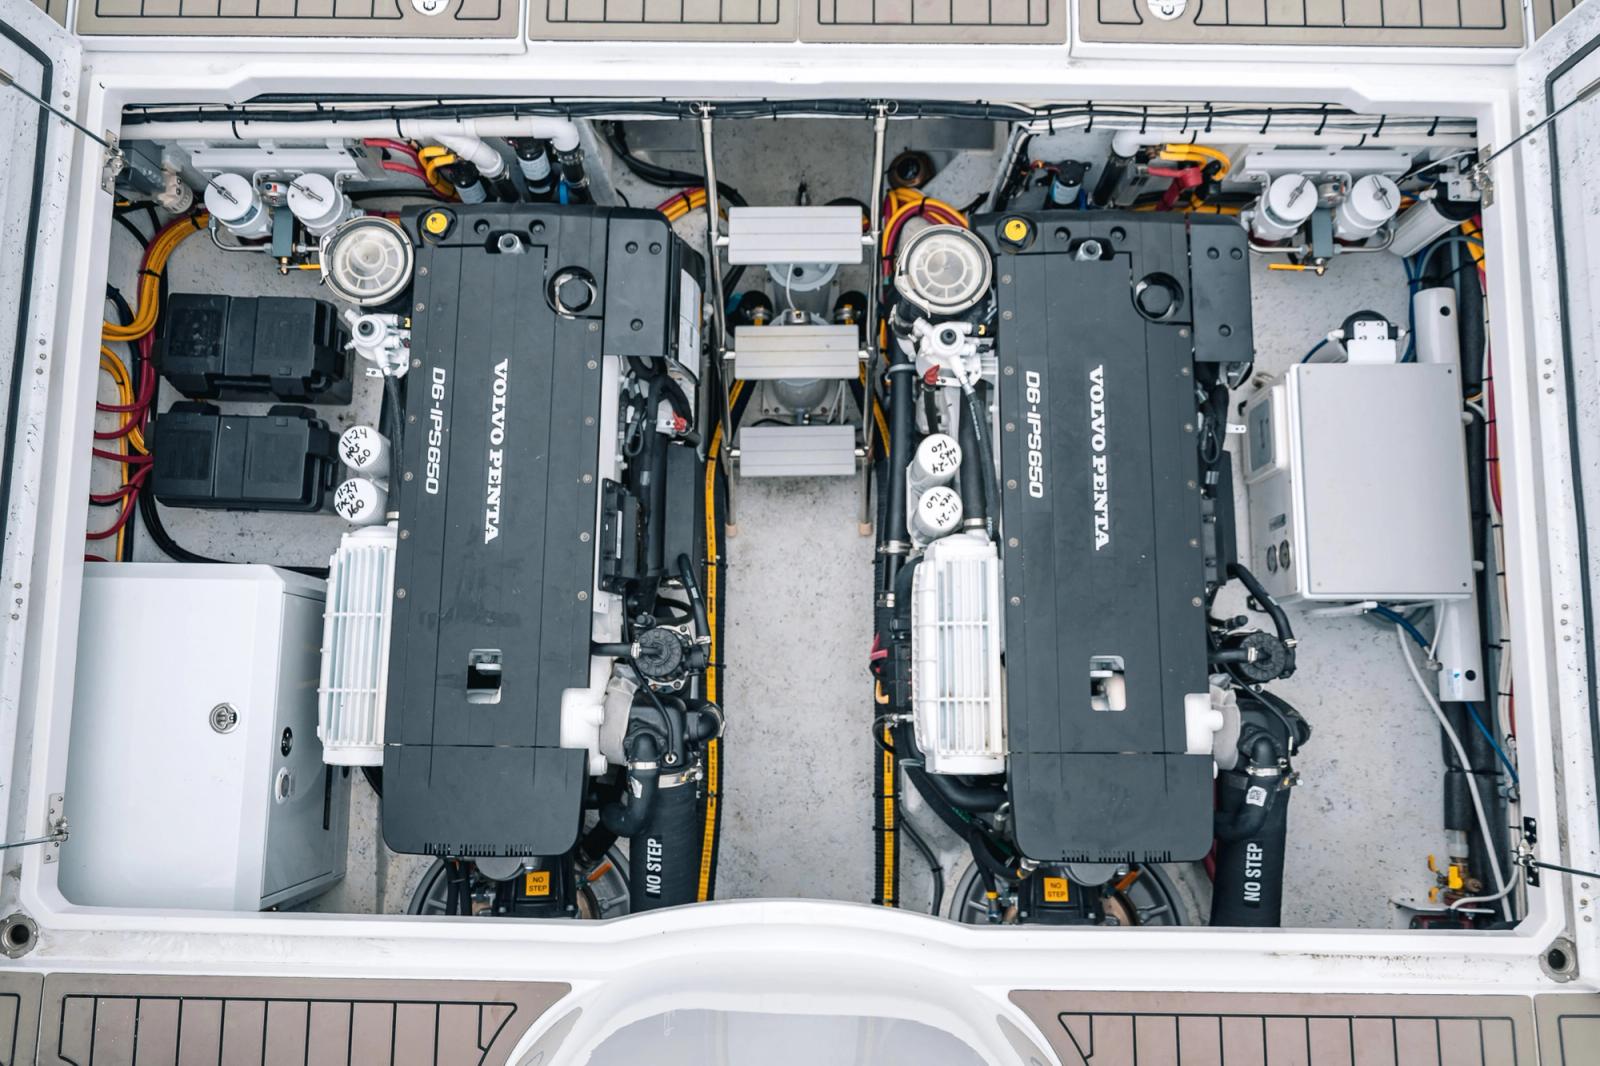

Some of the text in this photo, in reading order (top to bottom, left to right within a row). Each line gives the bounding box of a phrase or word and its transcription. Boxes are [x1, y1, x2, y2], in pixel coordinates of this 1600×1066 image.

[342, 428, 368, 448] 11-24
[425, 367, 446, 495] D6-IPS650
[485, 358, 508, 544] VOLVO PENTA
[1026, 370, 1043, 498] D6-IPS650
[354, 449, 371, 467] 160
[932, 456, 957, 475] 11-24
[1089, 364, 1109, 551] VOLVO PENTA
[337, 481, 358, 499] 11-24
[936, 503, 959, 527] 11-24
[646, 838, 662, 894] NO STEP
[1243, 843, 1263, 902] NO STEP
[529, 884, 547, 892] STEP
